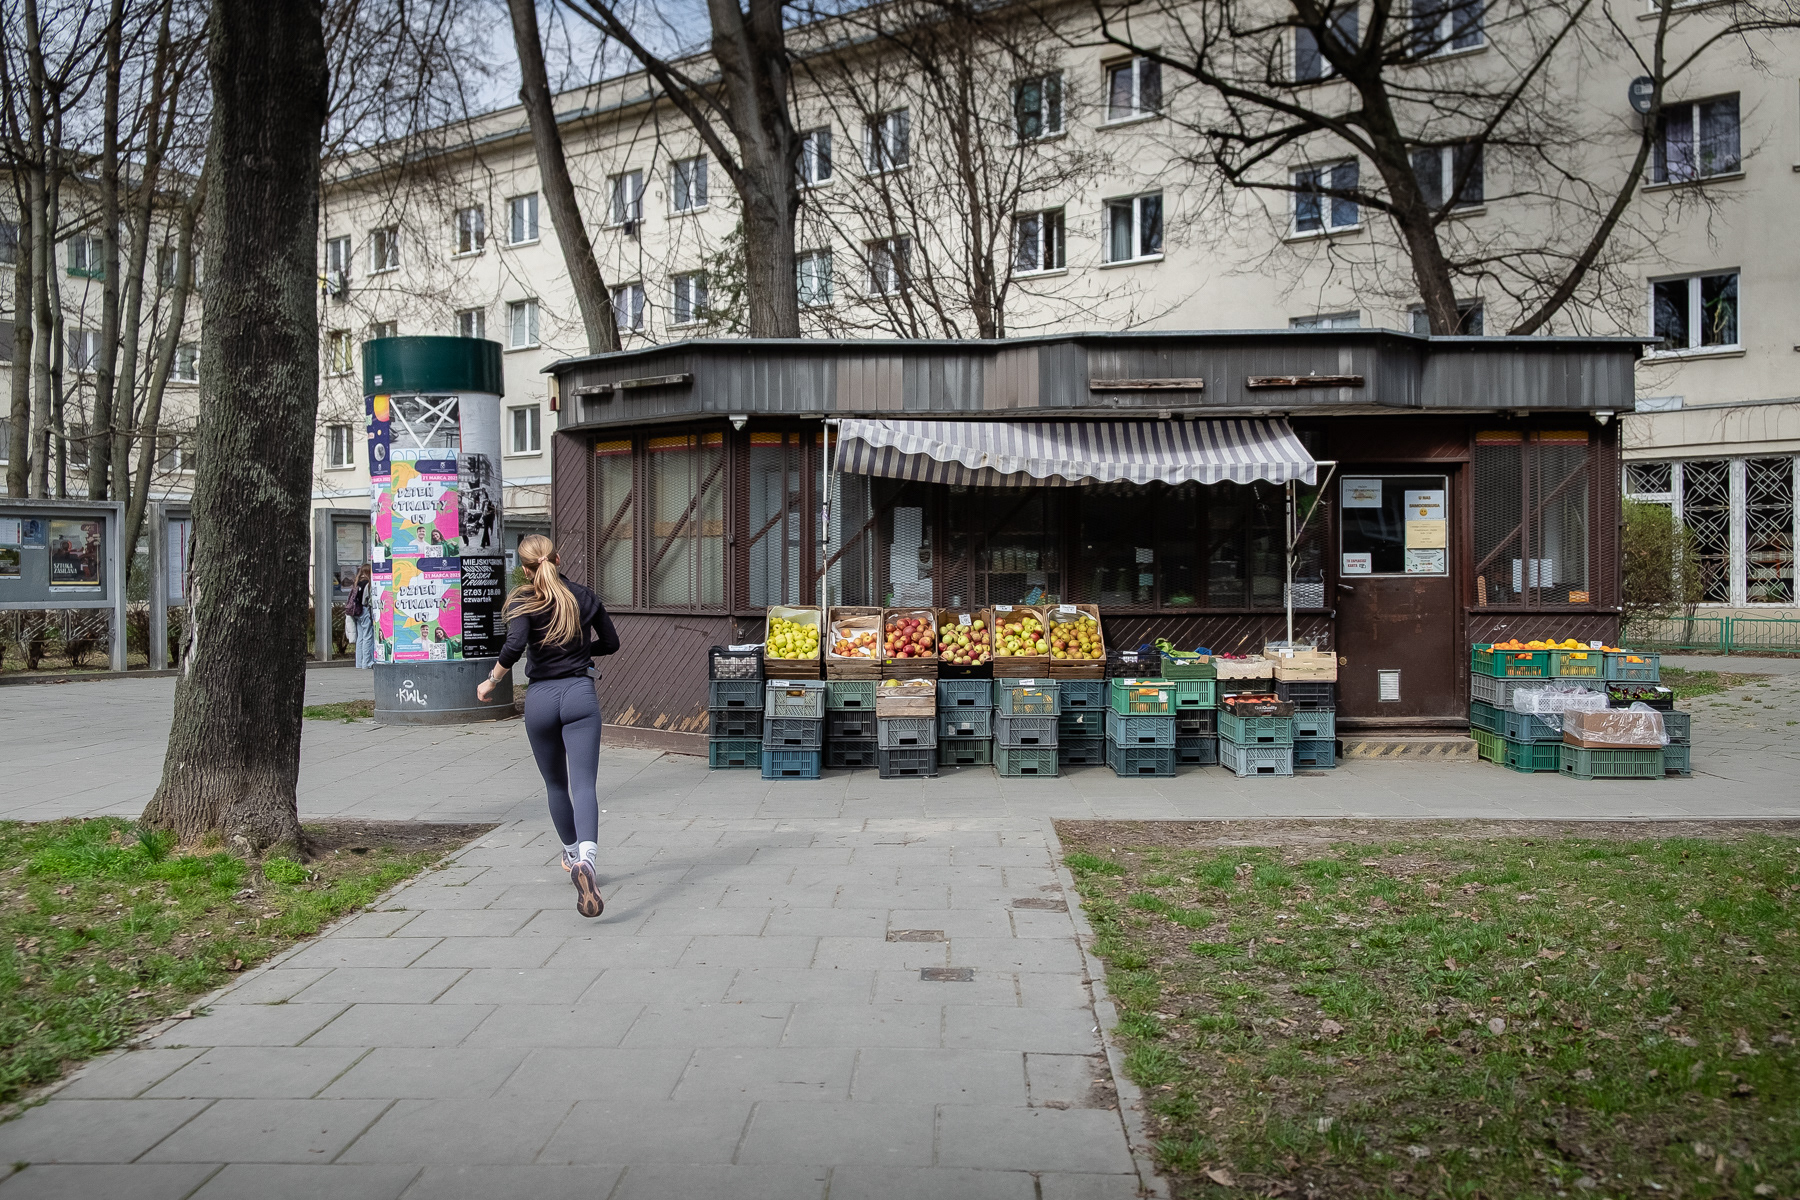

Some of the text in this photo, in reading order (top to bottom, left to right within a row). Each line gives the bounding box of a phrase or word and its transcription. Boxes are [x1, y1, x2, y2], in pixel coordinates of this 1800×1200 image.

[397, 482, 434, 498] DZIEŃ
[391, 501, 448, 512] OTWARTY
[411, 514, 427, 524] UJ
[399, 580, 436, 596] DZIEŃ
[395, 598, 450, 610] OTWARTY
[414, 611, 430, 622] UJ
